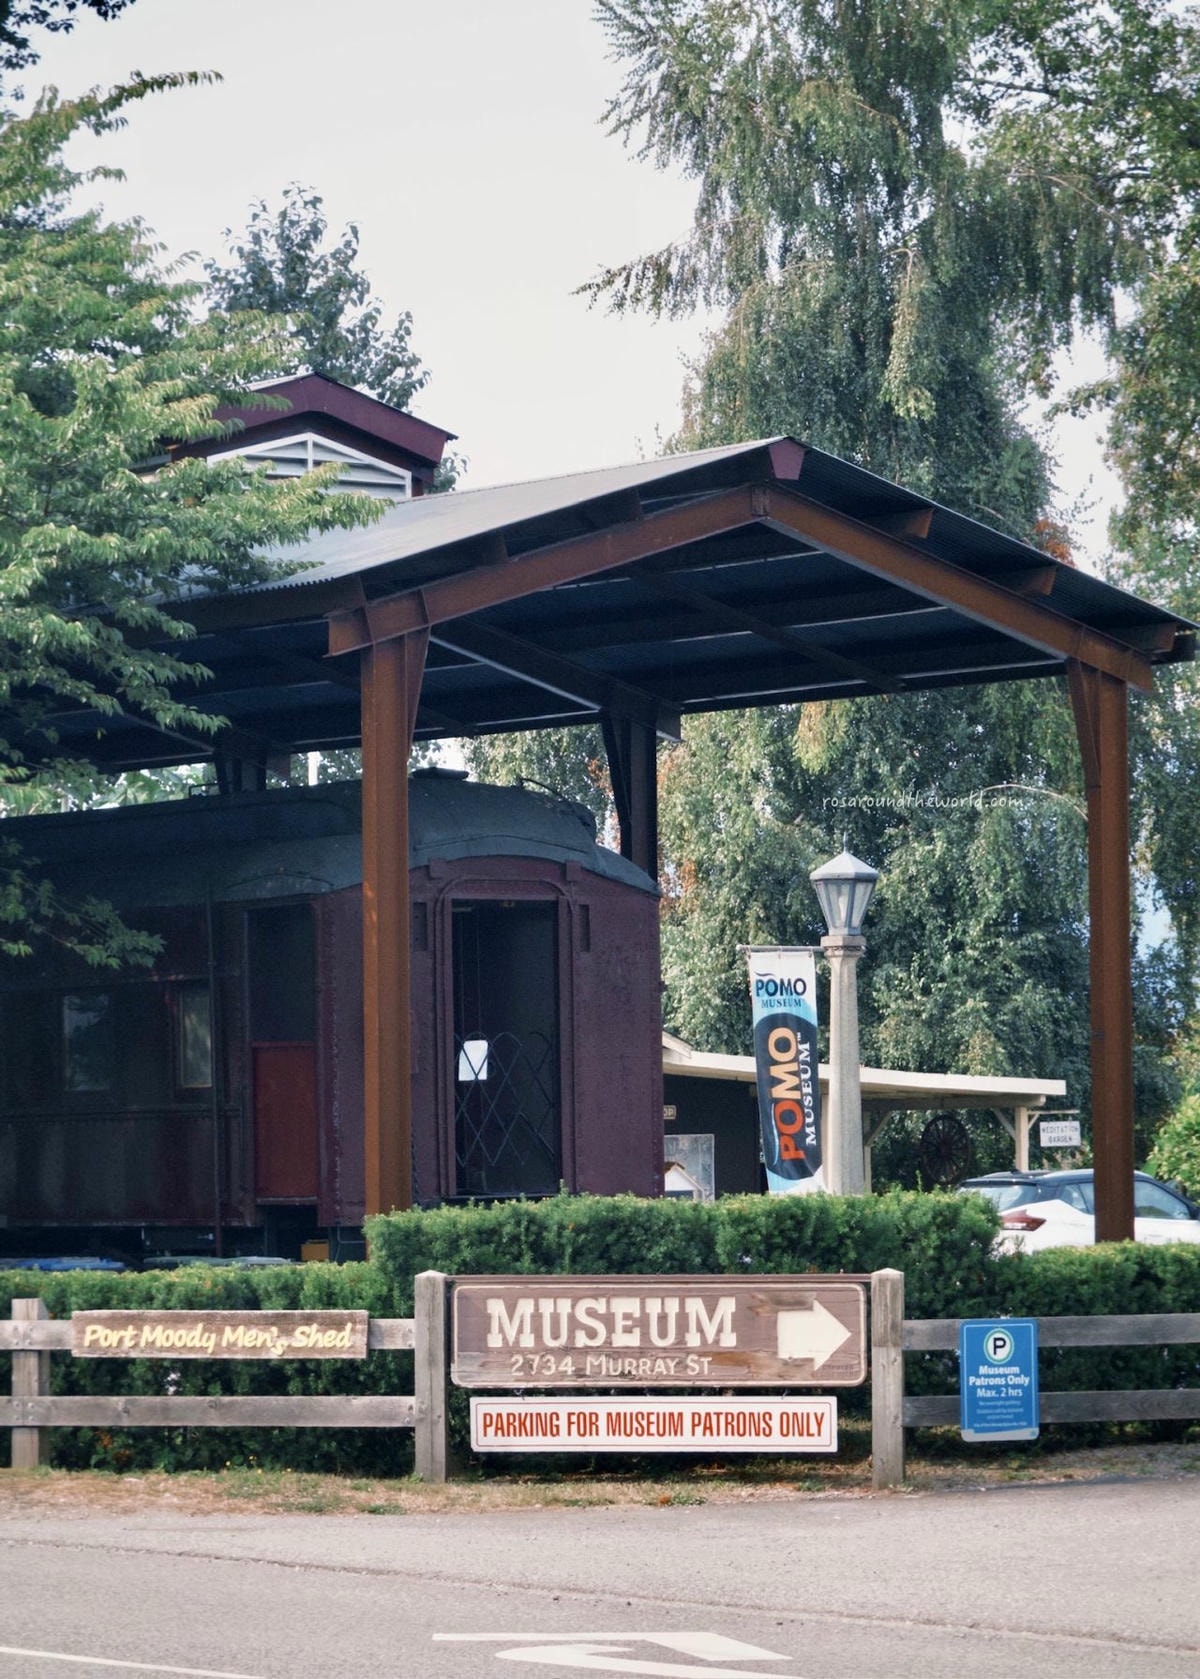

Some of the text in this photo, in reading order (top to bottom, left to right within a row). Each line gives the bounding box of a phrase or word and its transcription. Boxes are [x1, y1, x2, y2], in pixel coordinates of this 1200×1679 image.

[755, 977, 807, 997] POMO
[761, 999, 802, 1008] MUSEUM
[768, 1027, 806, 1161] POMO
[486, 1296, 737, 1347] MUSEUM
[84, 1323, 352, 1355] Port Moody Men's Shed
[993, 1337, 1006, 1355] P
[510, 1354, 576, 1376] 2734
[585, 1354, 678, 1376] MURRAY
[979, 1365, 1020, 1375] Museum
[968, 1374, 1030, 1387] Patrons Only
[977, 1387, 1023, 1397] Max. 2 hrs
[483, 1412, 825, 1437] PARKING FOR MUSEUM PATRONS ONLY
